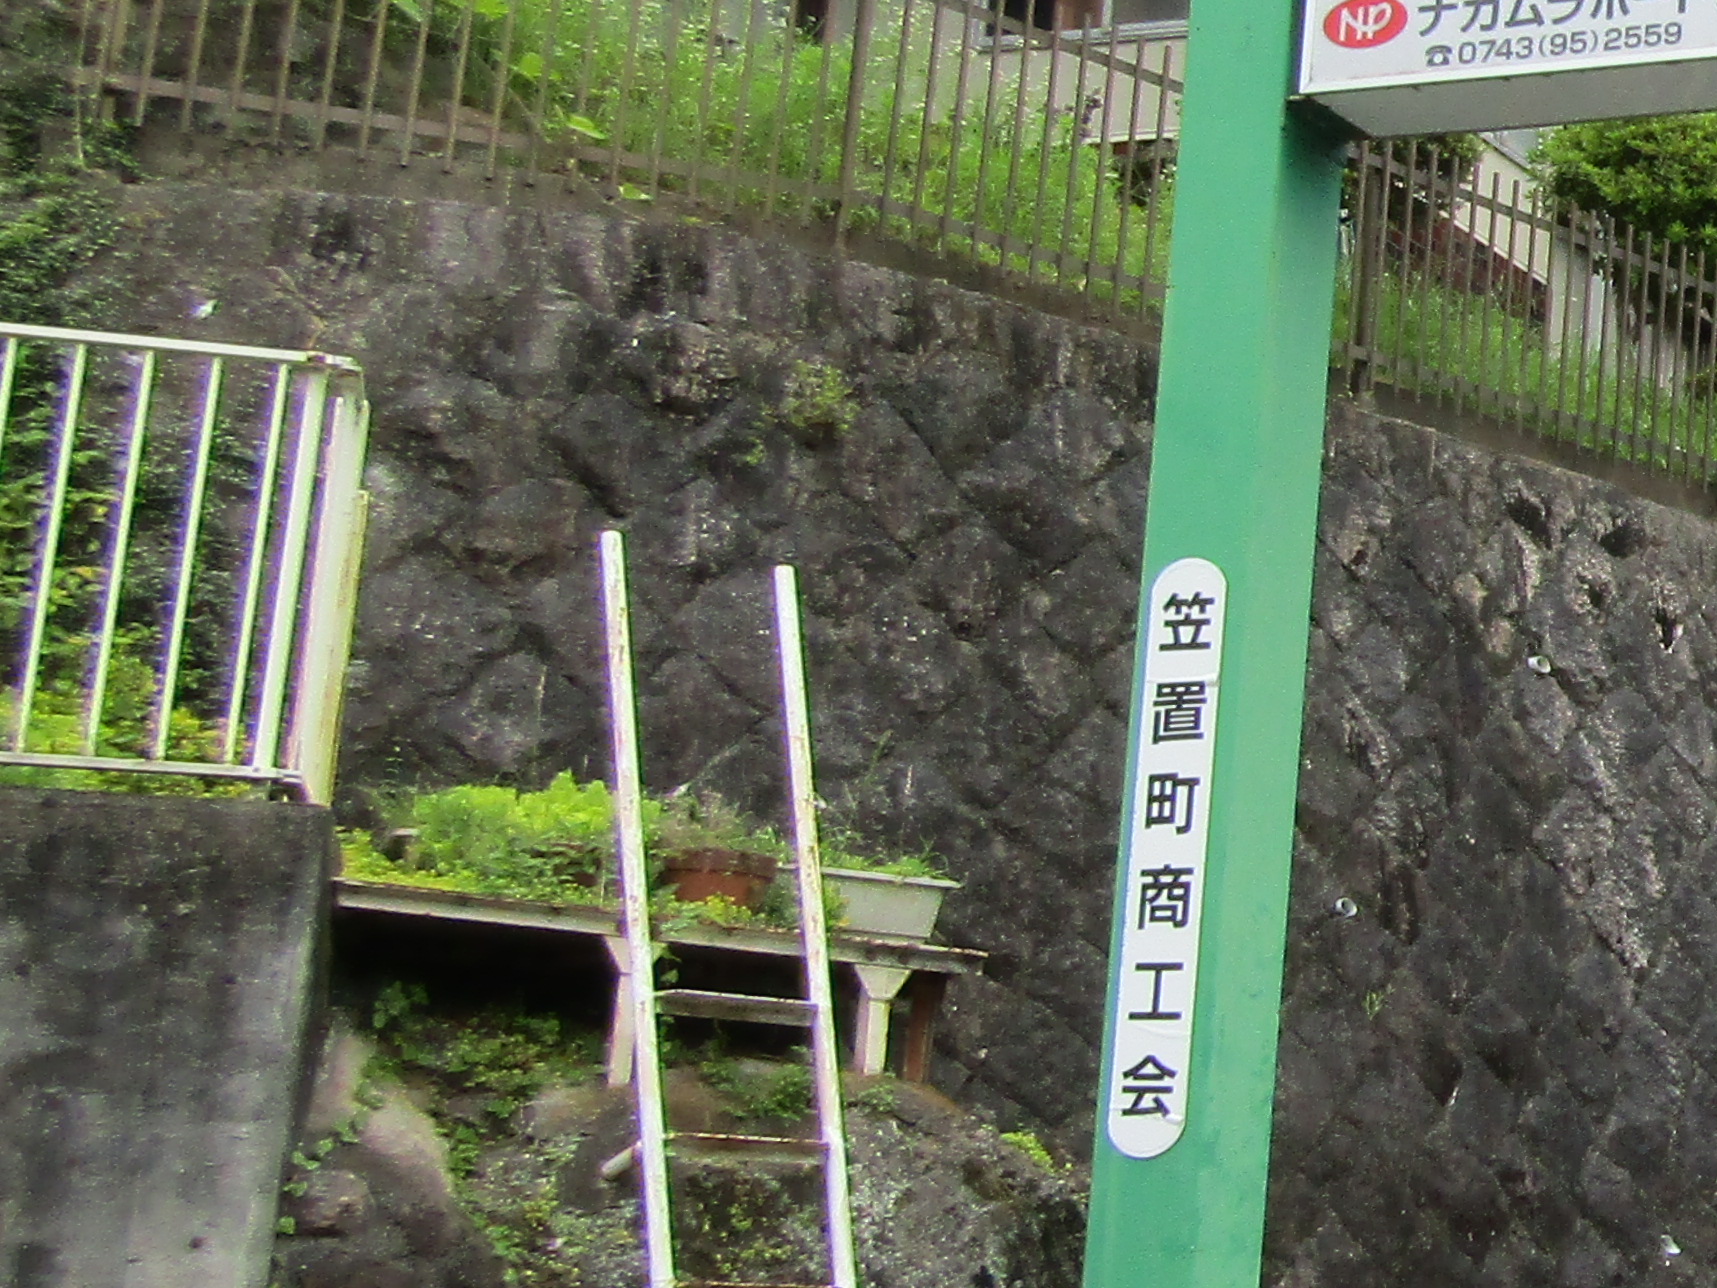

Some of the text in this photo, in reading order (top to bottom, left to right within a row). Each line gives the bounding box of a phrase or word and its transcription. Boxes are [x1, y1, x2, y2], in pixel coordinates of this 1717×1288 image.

[1458, 22, 1683, 65] 0743(95)2559
[1121, 591, 1216, 1119] 笠置町商工会
